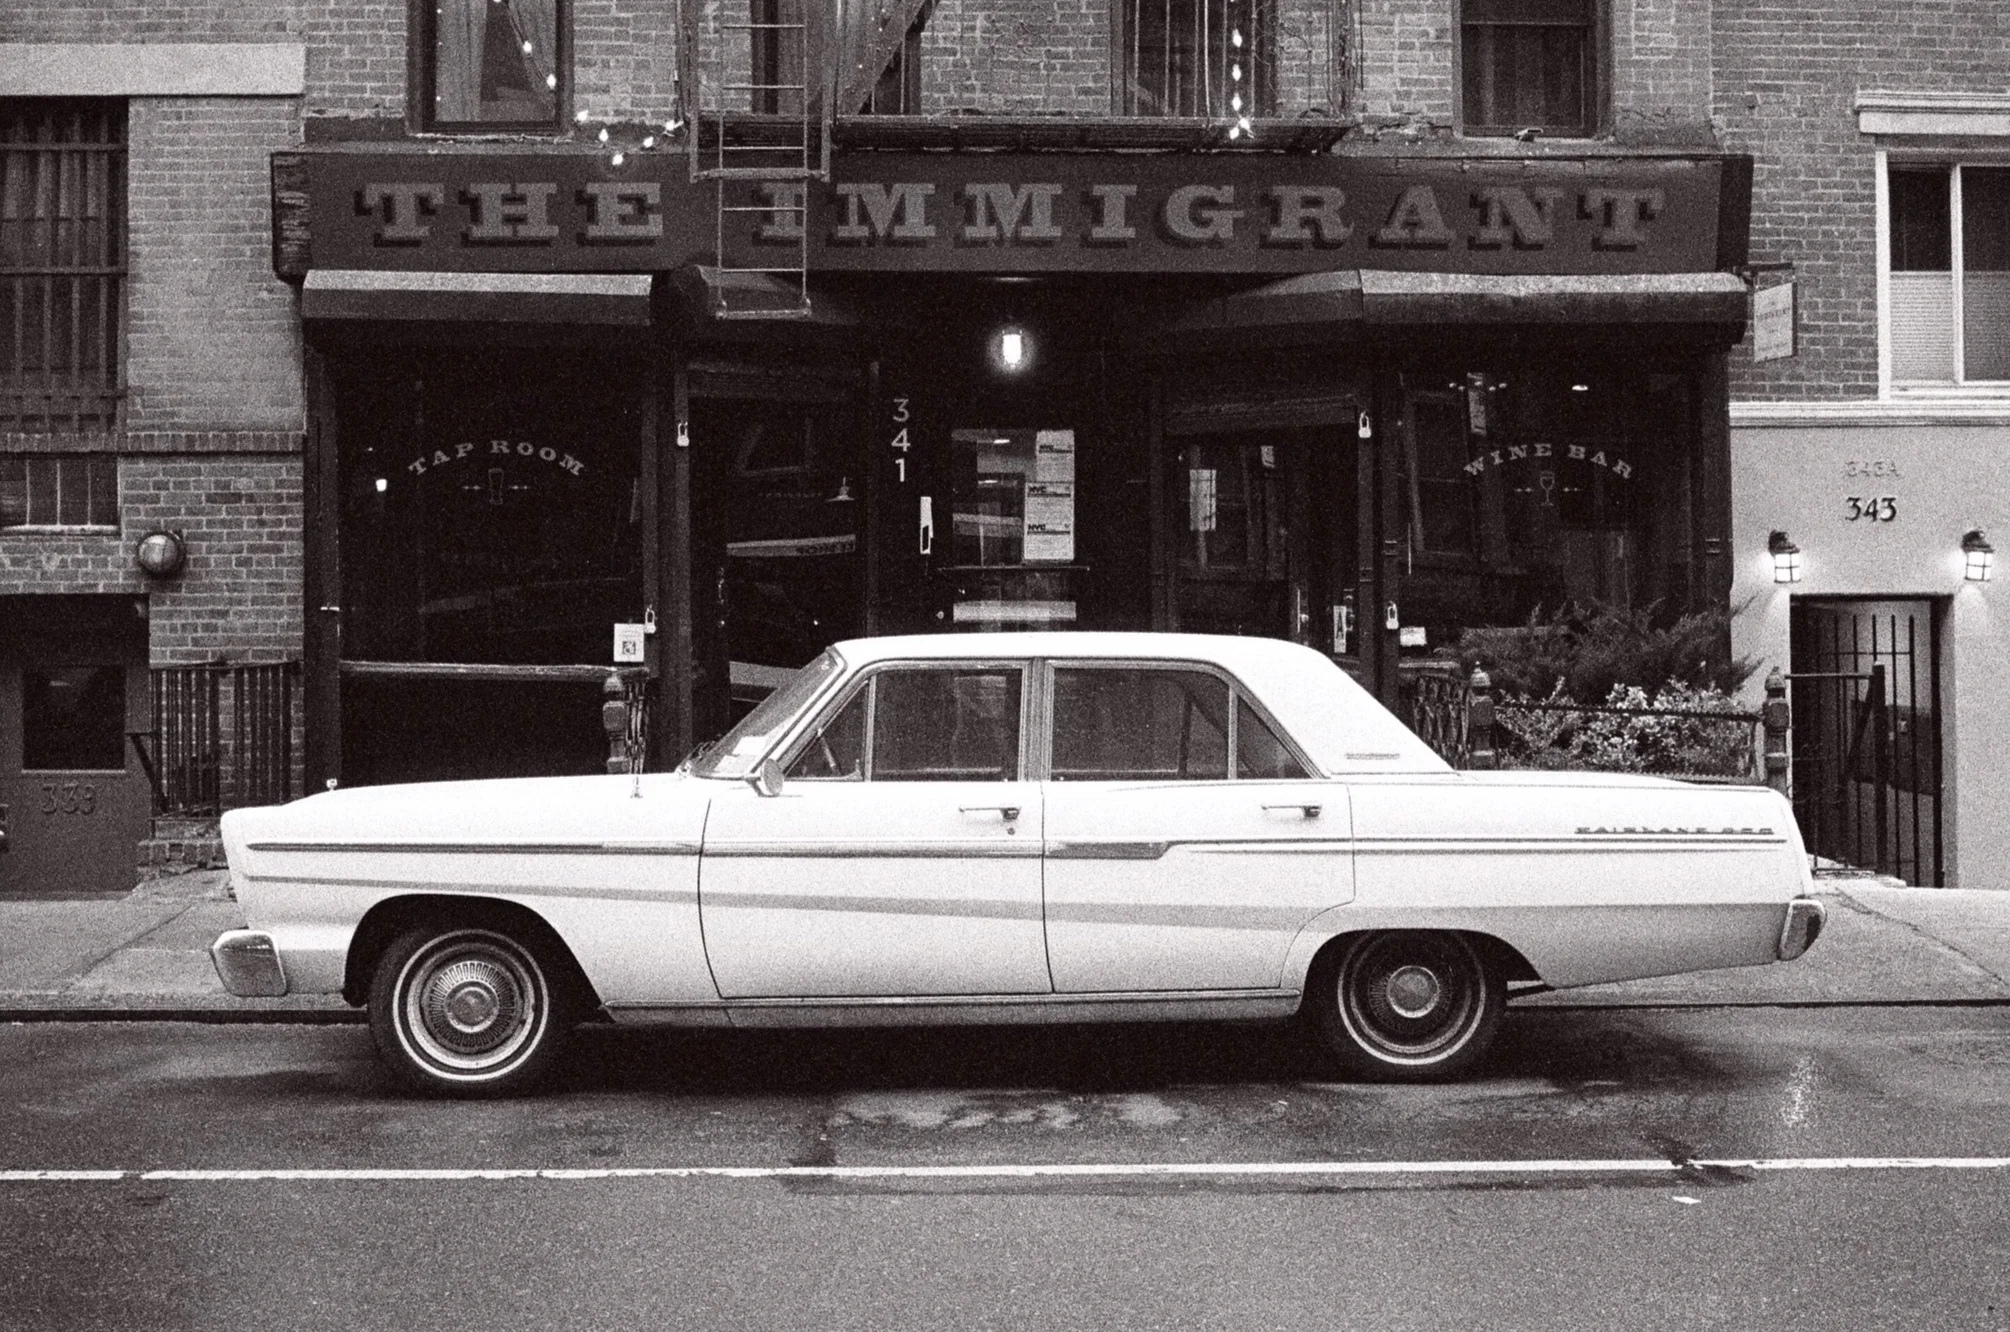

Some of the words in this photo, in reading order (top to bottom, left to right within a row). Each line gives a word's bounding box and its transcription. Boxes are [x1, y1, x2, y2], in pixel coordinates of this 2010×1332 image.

[358, 183, 663, 246] THE
[755, 183, 1665, 249] IMMIGRANT
[408, 442, 474, 475] TAP
[489, 440, 584, 475] ROOM
[891, 399, 911, 482] 341
[1463, 443, 1552, 475] WINE
[1567, 444, 1632, 479] BAR
[1845, 497, 1897, 521] 343
